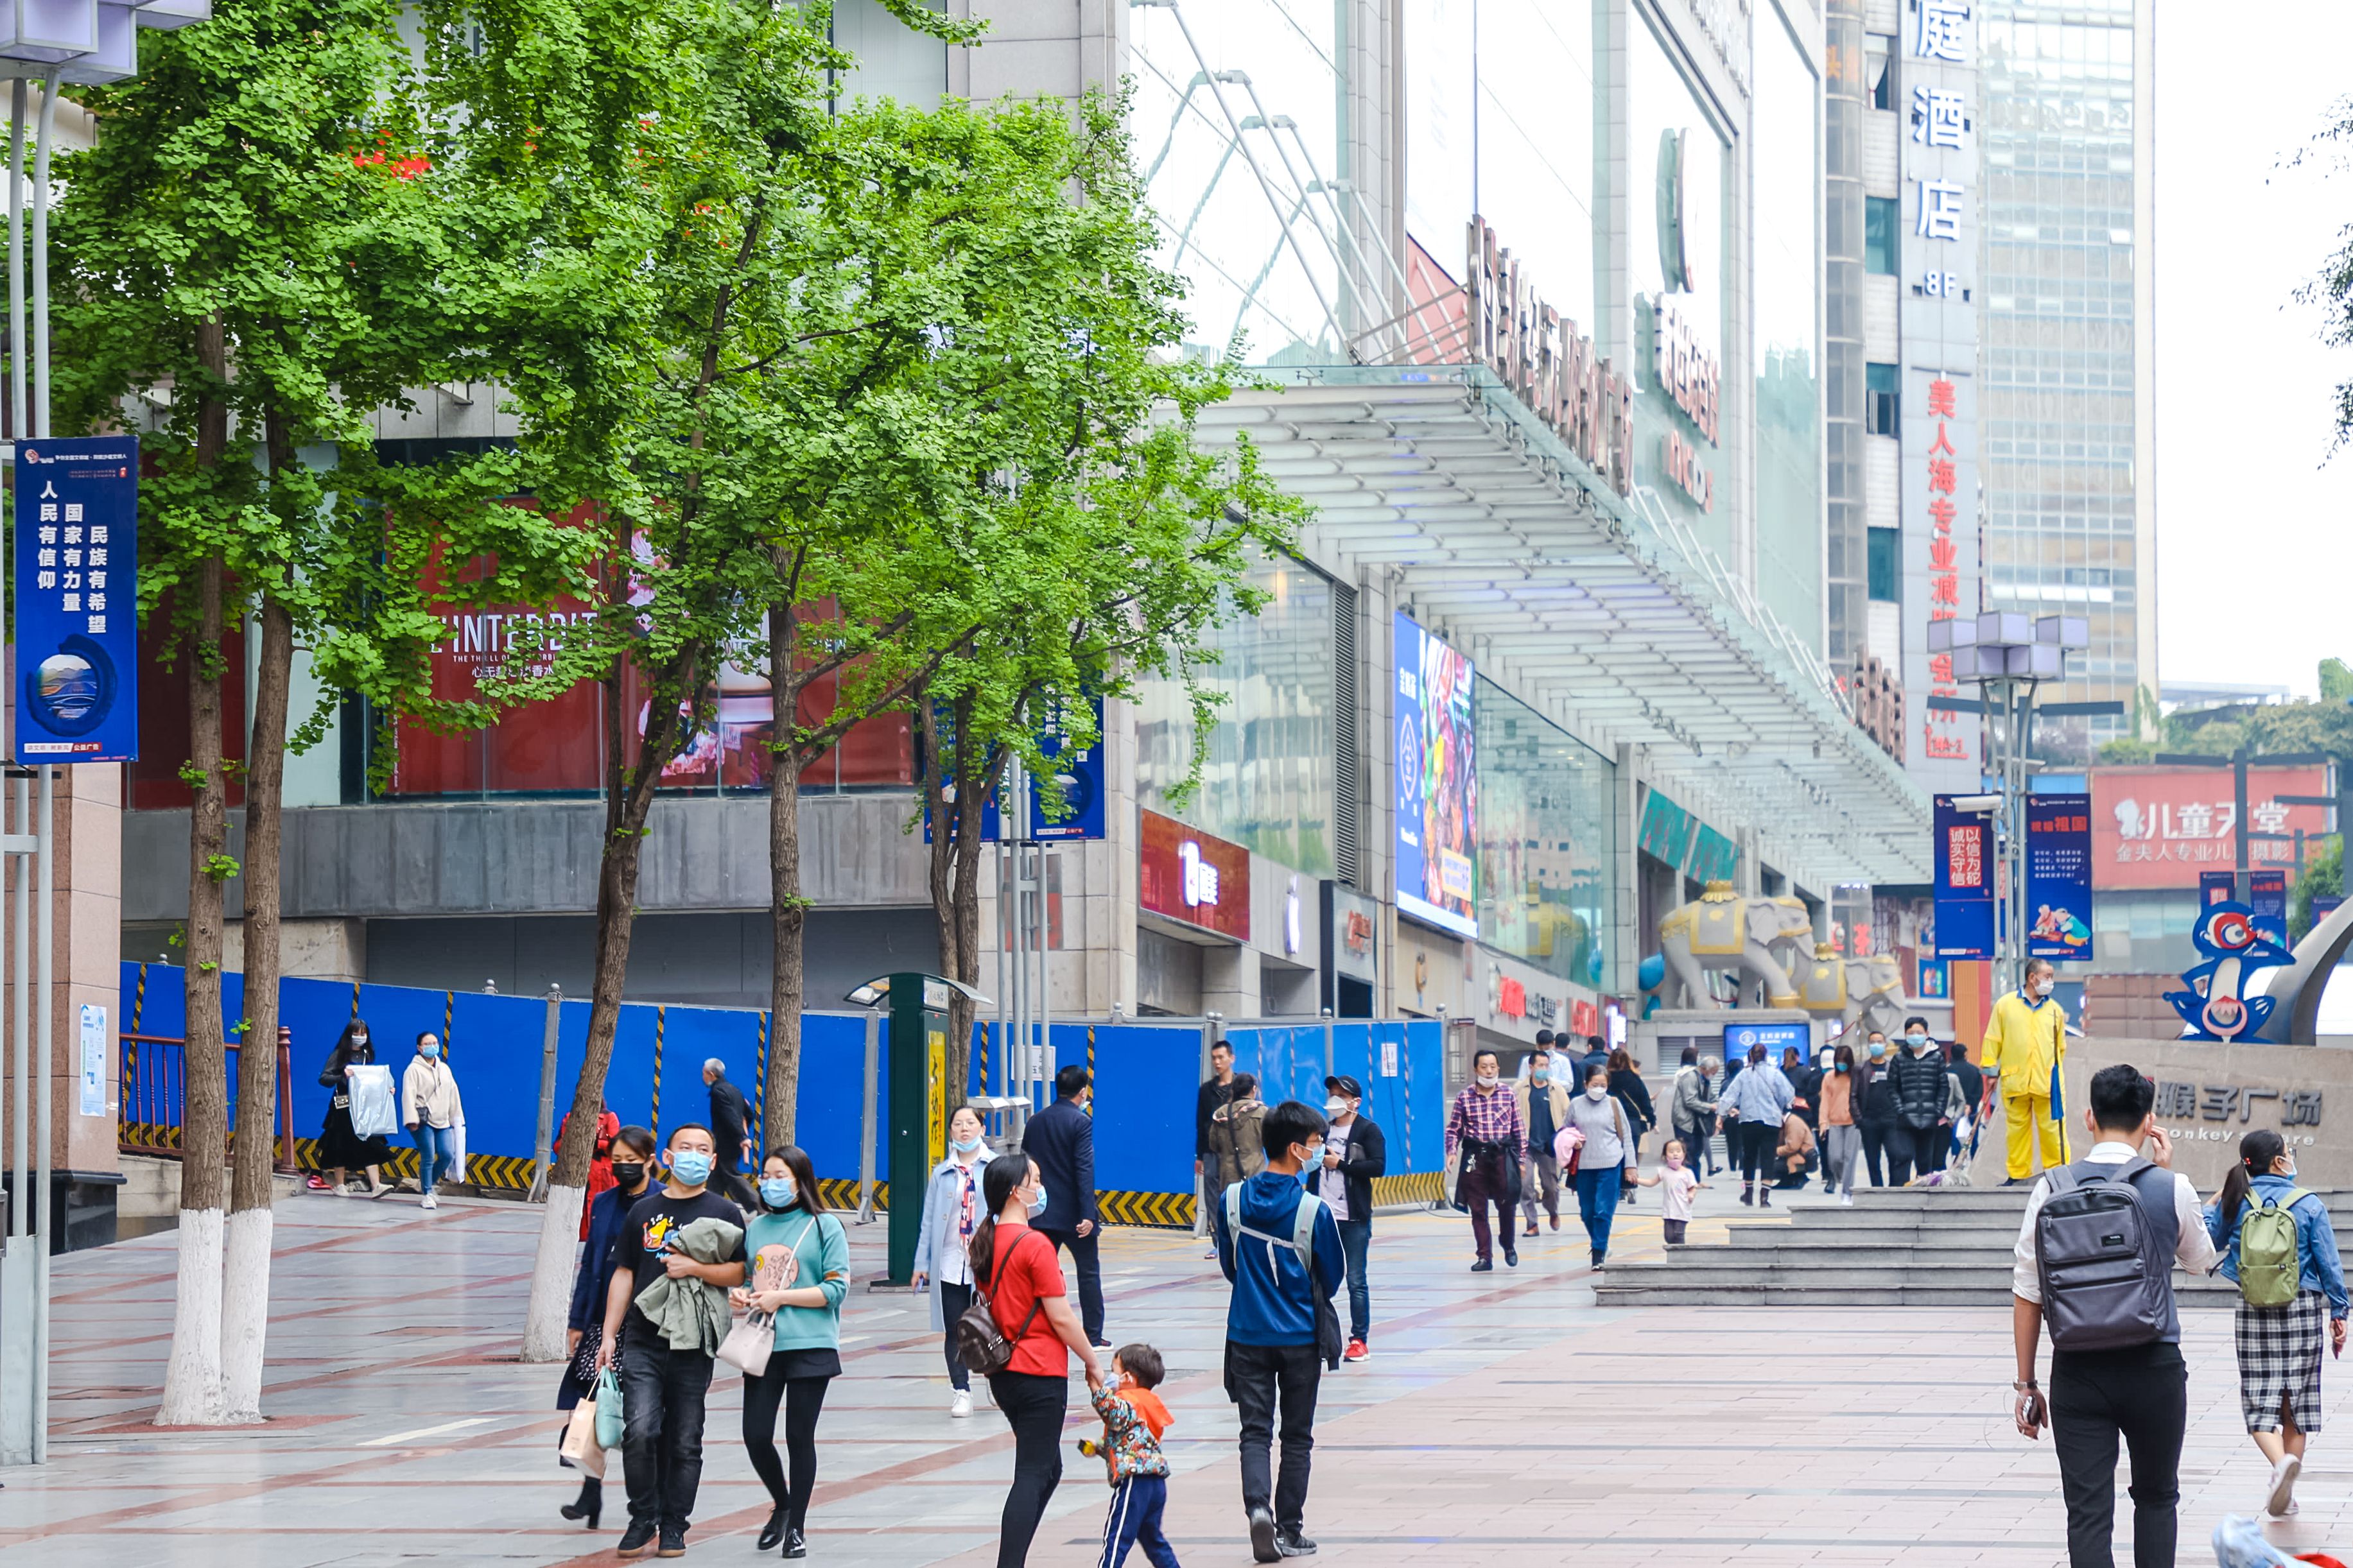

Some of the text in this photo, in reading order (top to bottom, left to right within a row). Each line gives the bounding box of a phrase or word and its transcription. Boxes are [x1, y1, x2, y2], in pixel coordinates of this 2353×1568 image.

[1913, 0, 1969, 241] 庭酒店
[1925, 271, 1956, 298] 8F
[38, 480, 58, 589] 人民有信仰
[62, 504, 83, 612] 国家有力量
[1928, 379, 1959, 724] 美人海专业减会所
[87, 526, 108, 633] 民族有希望
[2145, 800, 2290, 840] 儿童天堂
[1951, 829, 1965, 886] 诚实守信
[2116, 843, 2290, 862] 金夫人专业儿摄影
[2156, 1081, 2322, 1126] 猴子广场
[2167, 1127, 2234, 1142] onkey
